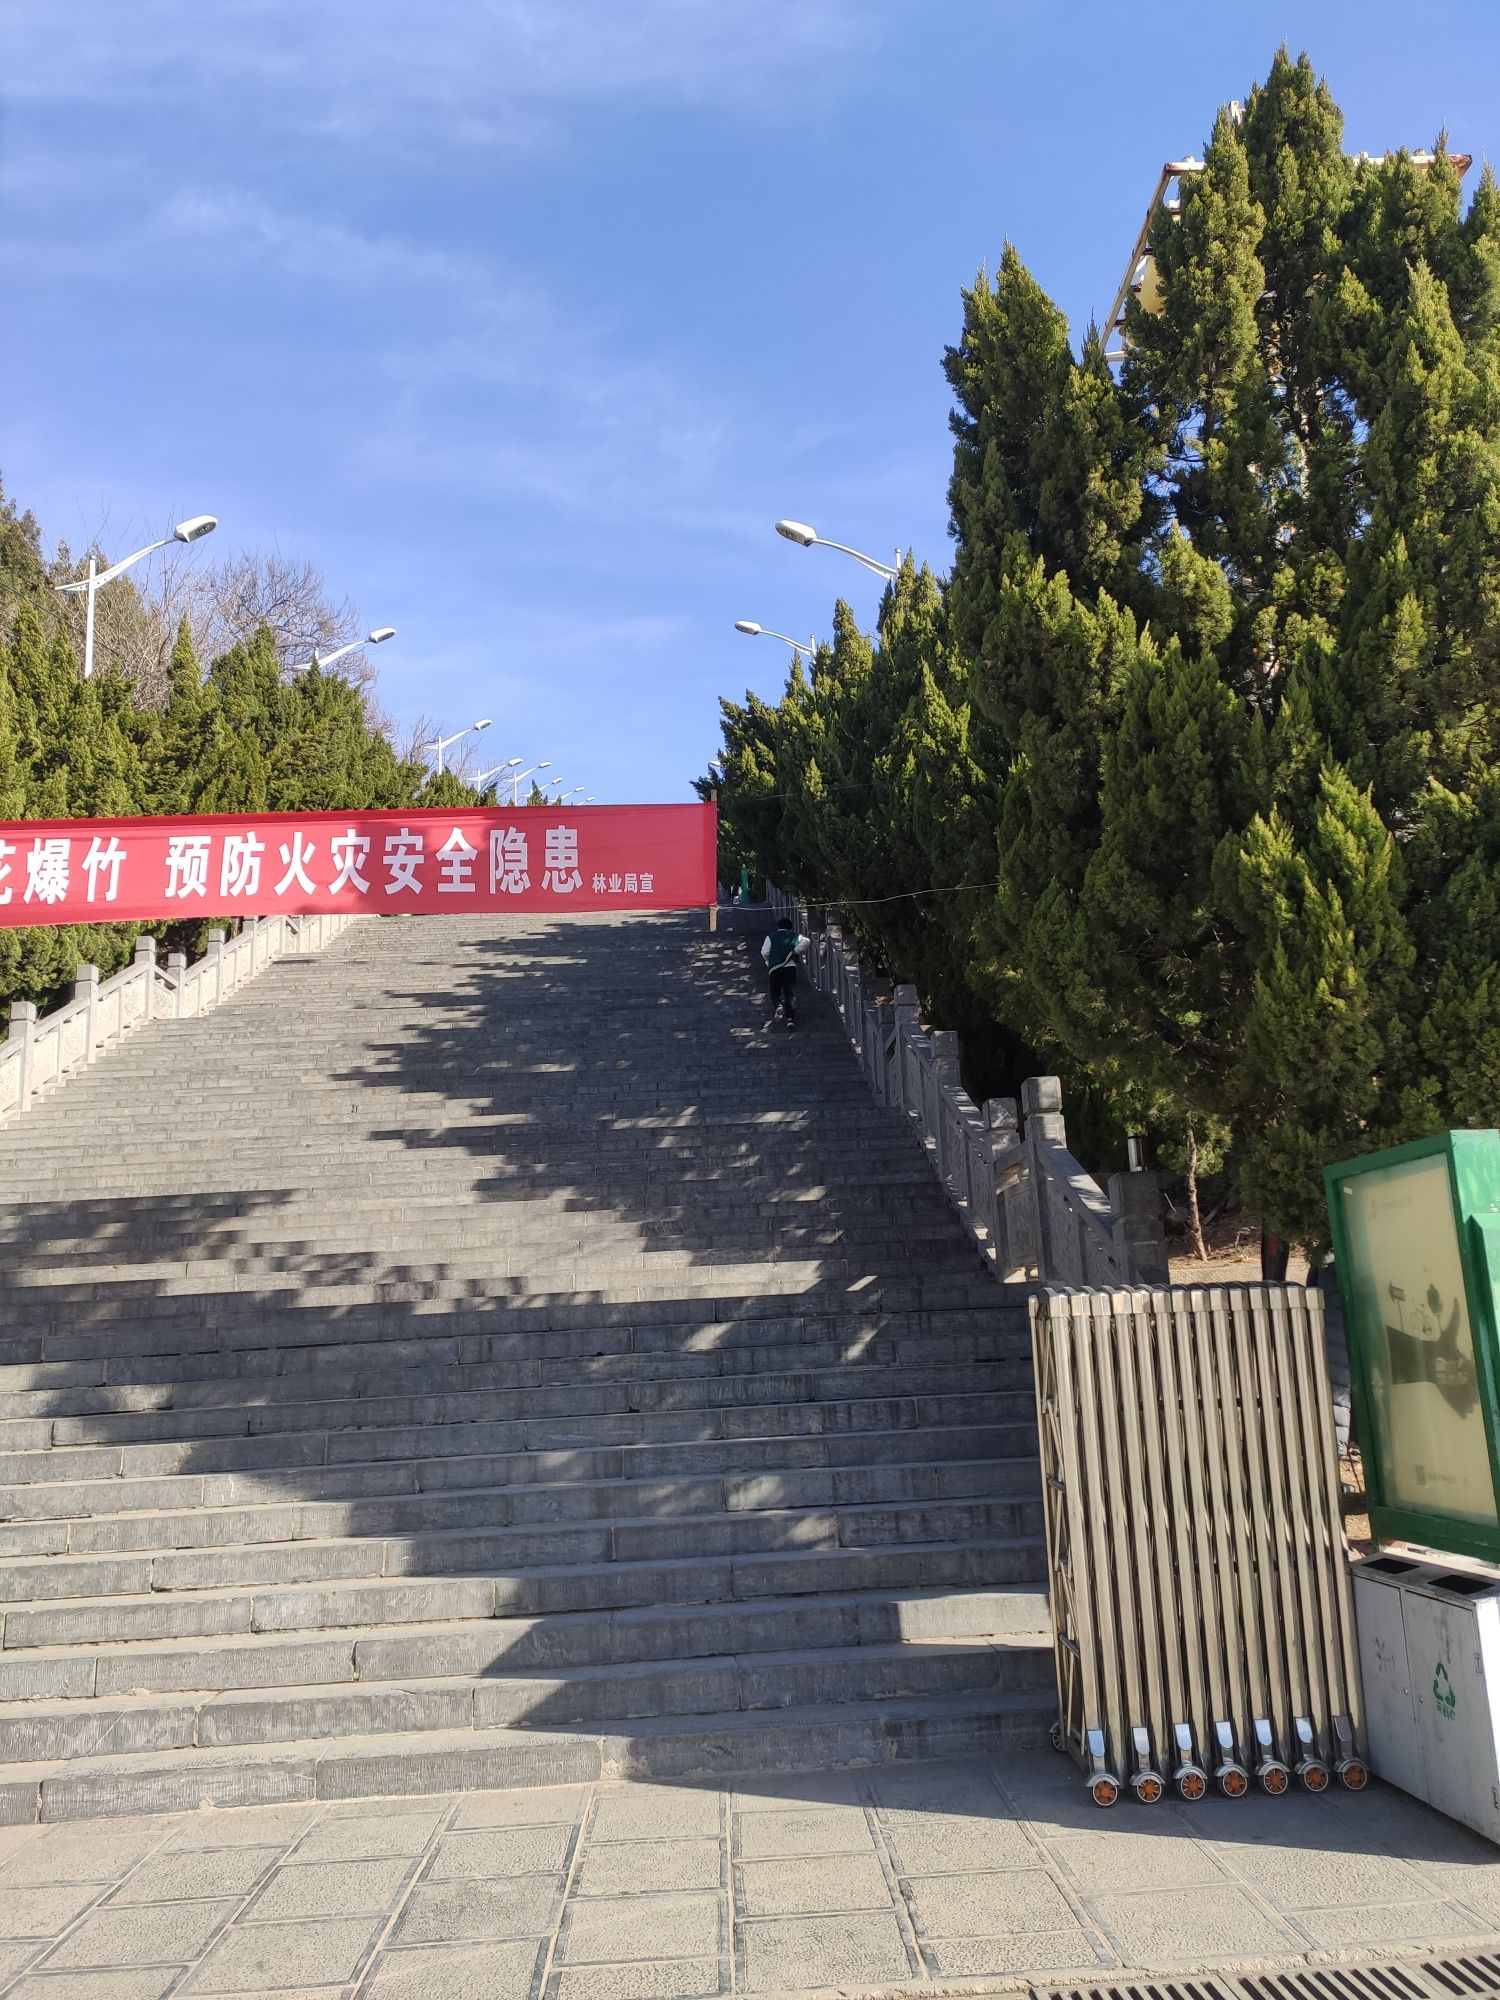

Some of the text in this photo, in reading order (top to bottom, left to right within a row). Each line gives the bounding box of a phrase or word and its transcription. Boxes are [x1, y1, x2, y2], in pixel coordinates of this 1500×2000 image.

[164, 824, 583, 899] 预防火灾安全隐患
[592, 872, 654, 893] 林业局宣
